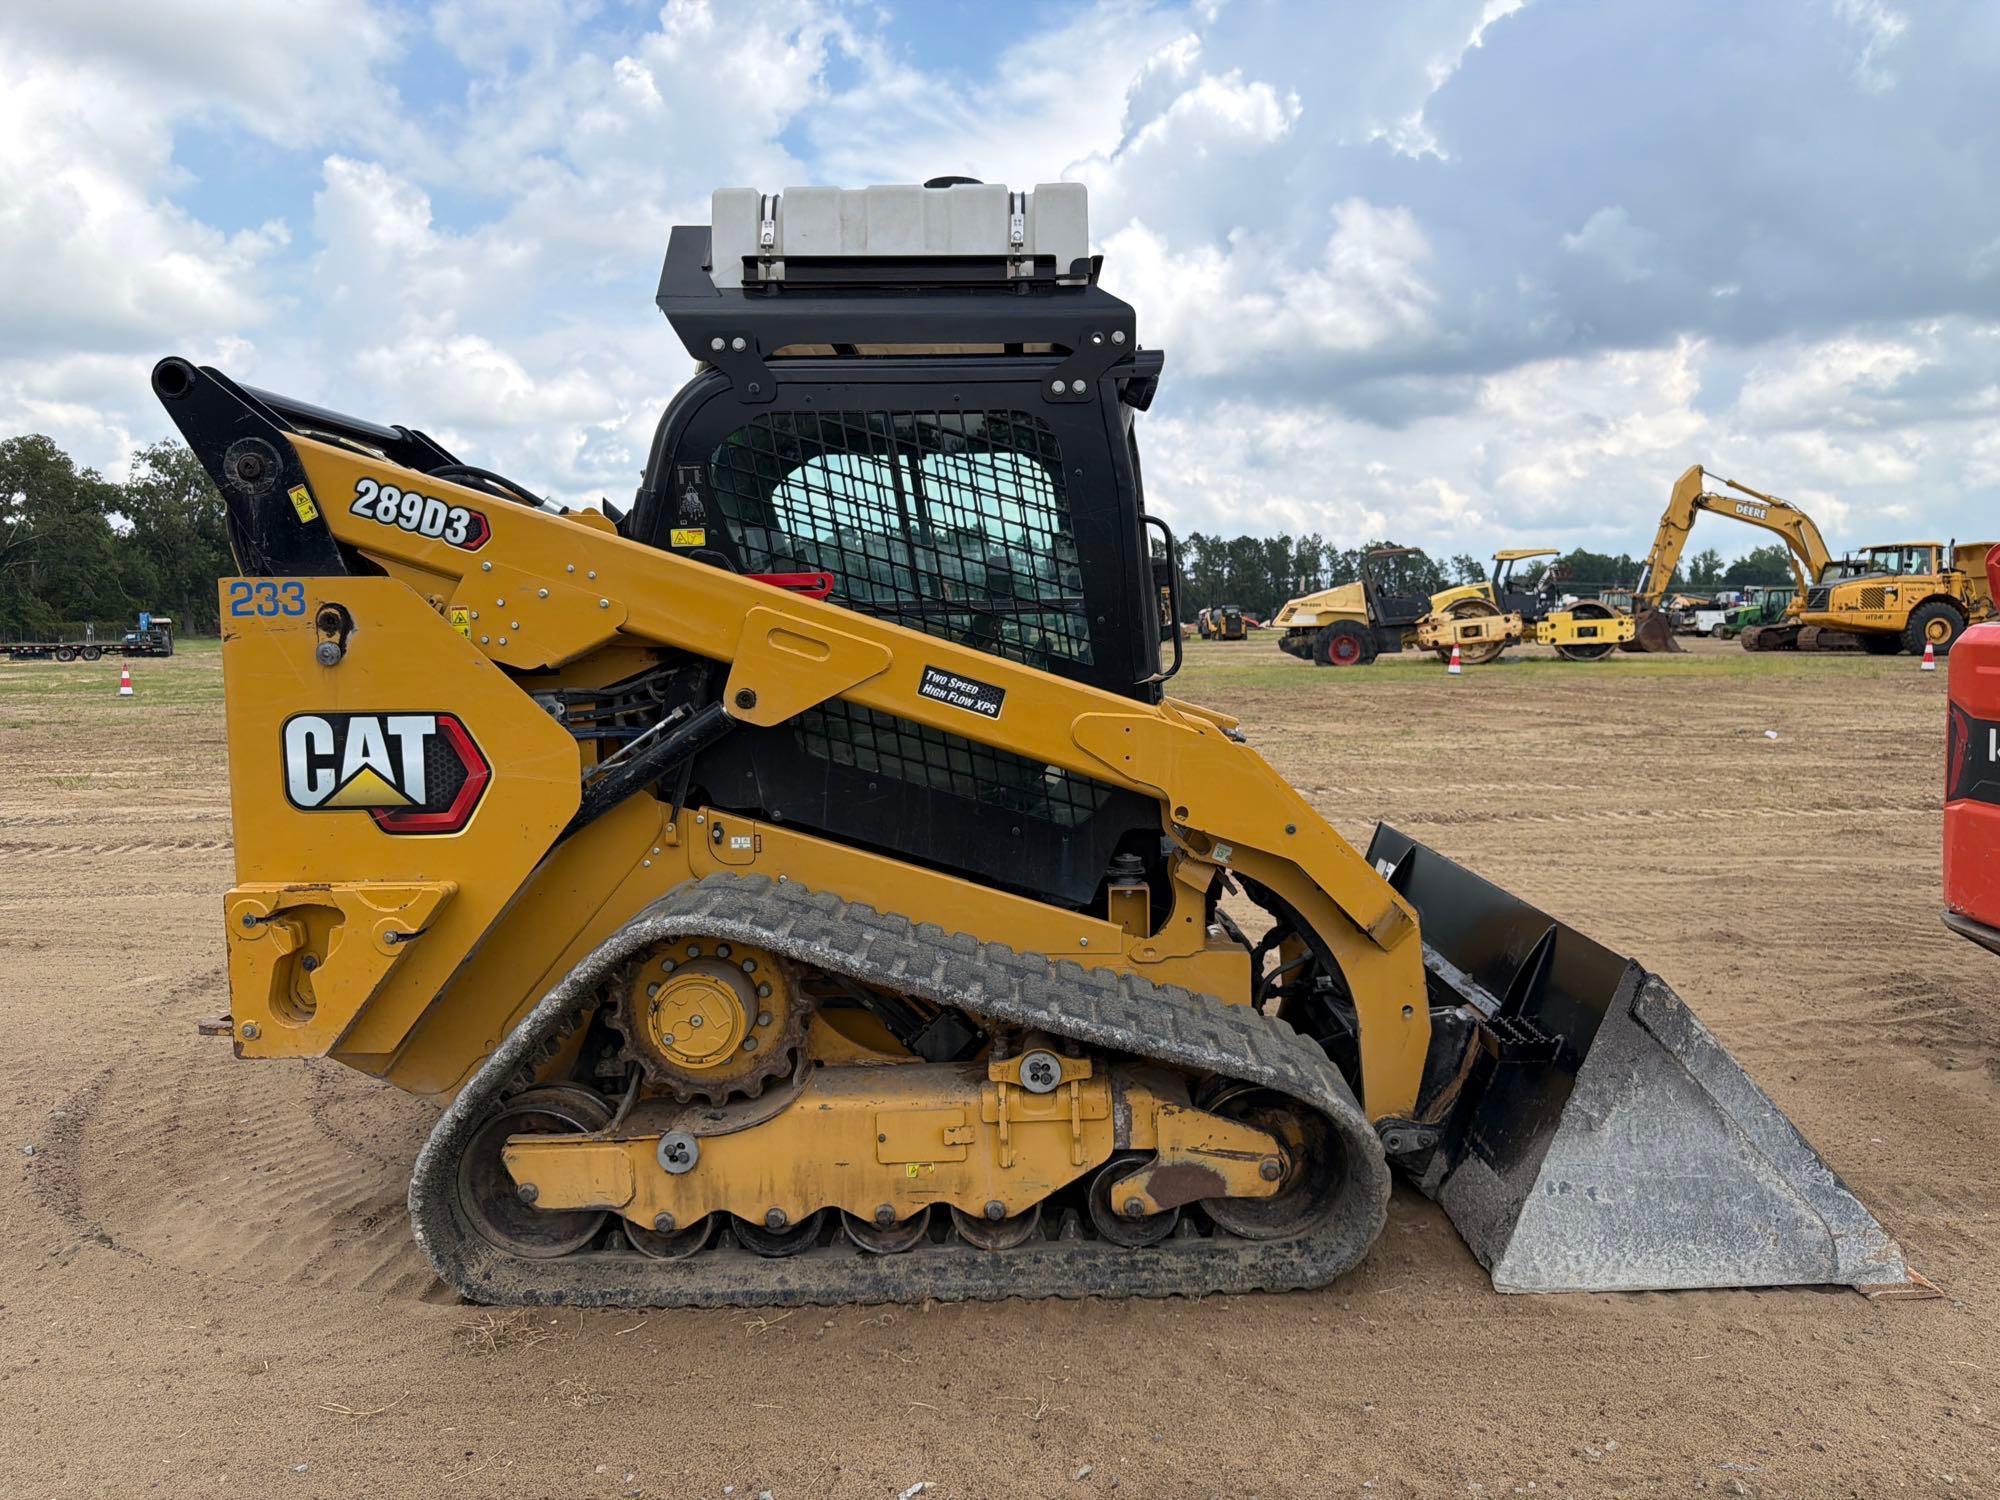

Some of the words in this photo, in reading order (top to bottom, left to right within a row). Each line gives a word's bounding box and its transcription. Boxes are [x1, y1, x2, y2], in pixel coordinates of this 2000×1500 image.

[351, 479, 471, 545] 289D3
[1735, 503, 1767, 519] DEERE
[230, 581, 306, 617] 233
[922, 683, 947, 699] HIGH
[947, 691, 974, 707] FLOW
[974, 699, 998, 714] XPS
[925, 670, 948, 685] TWO
[948, 677, 979, 695] SPEED
[285, 715, 437, 808] CAT
